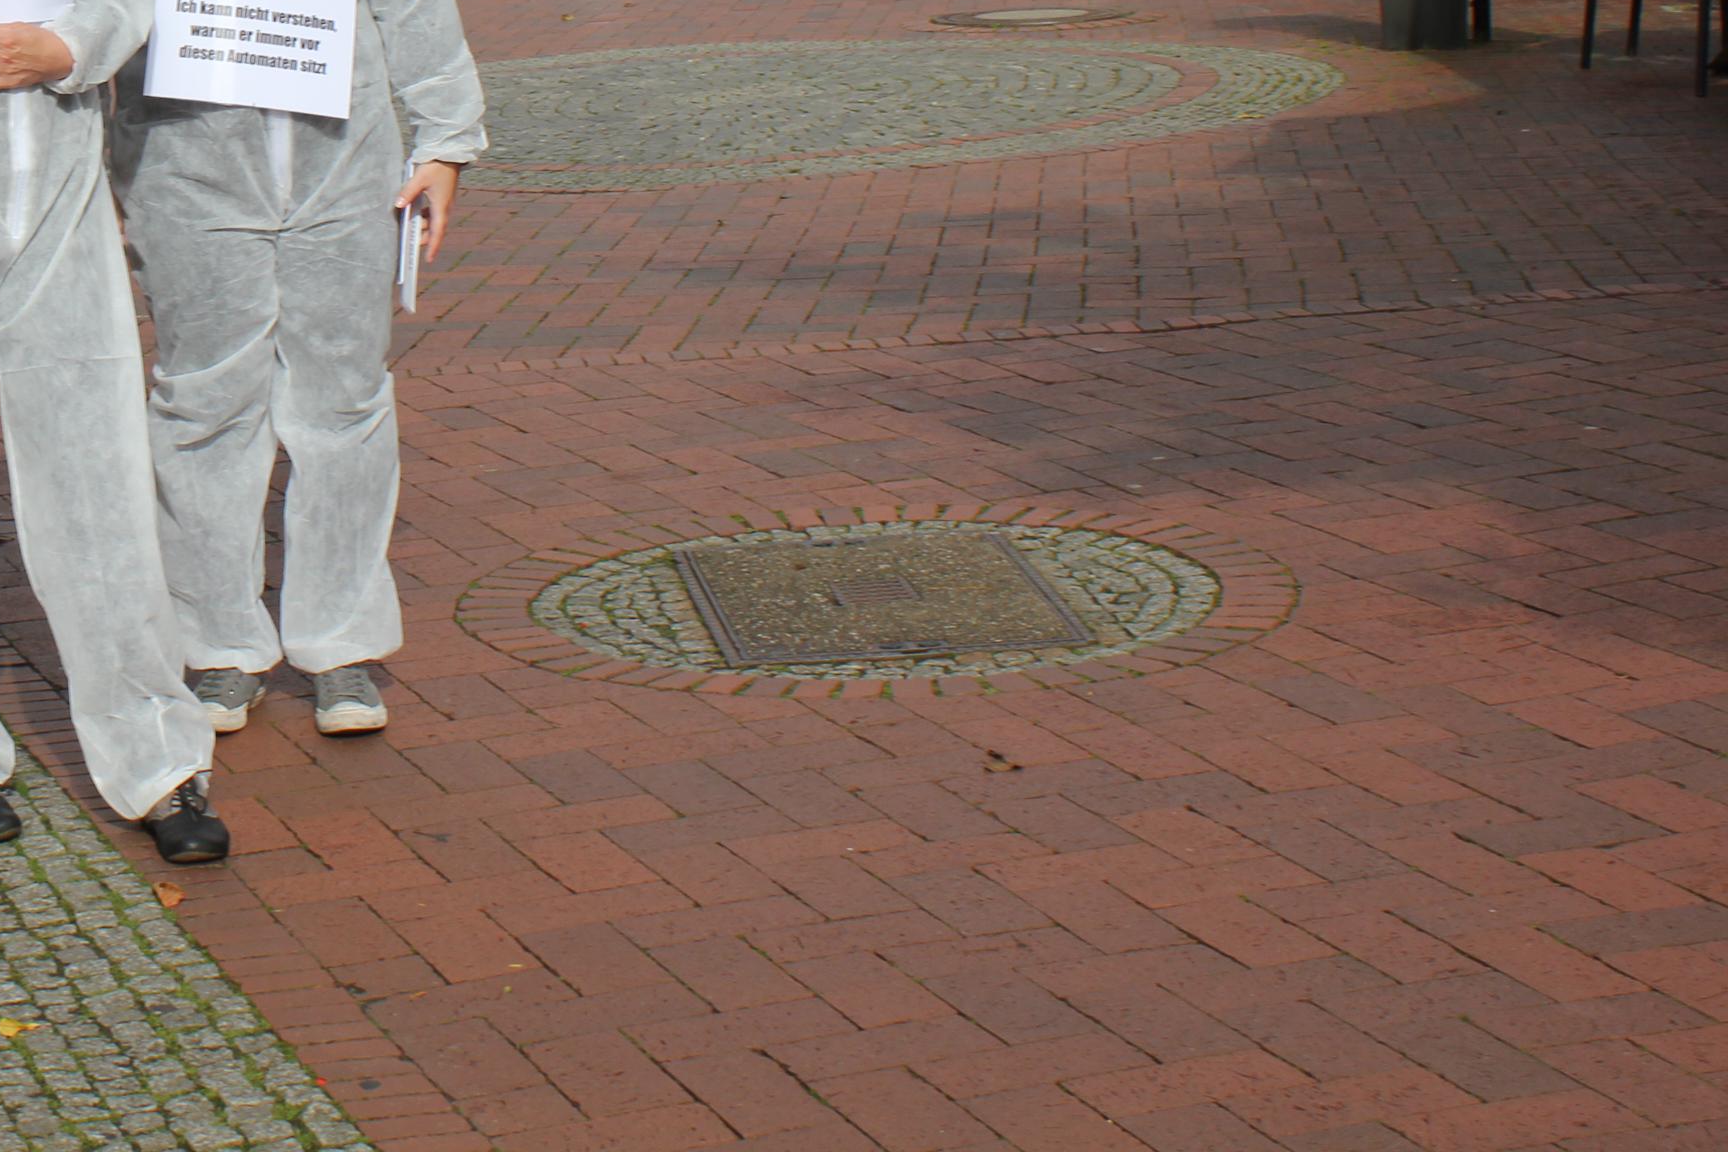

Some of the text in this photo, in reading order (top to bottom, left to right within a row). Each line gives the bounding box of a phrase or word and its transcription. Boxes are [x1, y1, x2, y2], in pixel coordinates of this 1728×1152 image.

[176, 0, 337, 32] Ich kann nicht verstehen,
[190, 24, 320, 51] warum er immer vor
[179, 45, 327, 75] diesen Automaten sitzt
